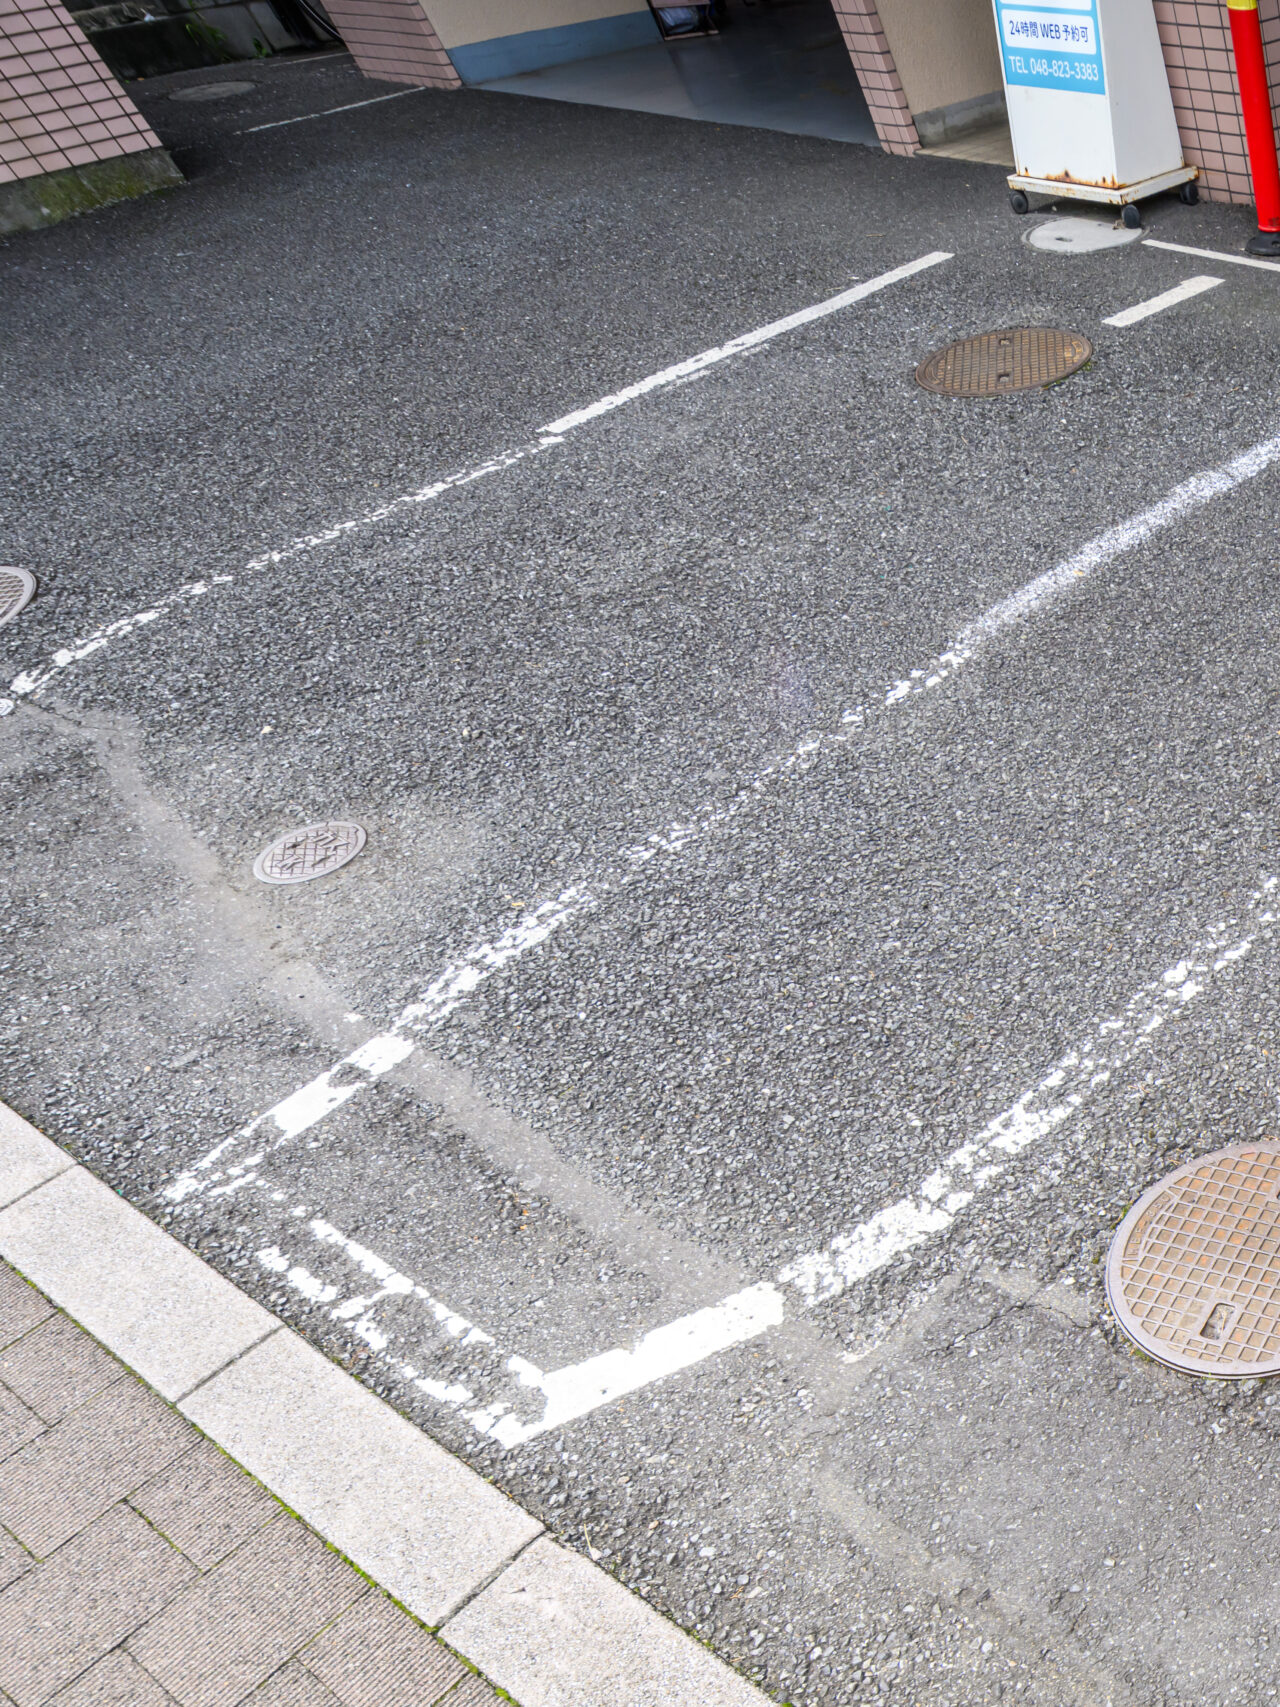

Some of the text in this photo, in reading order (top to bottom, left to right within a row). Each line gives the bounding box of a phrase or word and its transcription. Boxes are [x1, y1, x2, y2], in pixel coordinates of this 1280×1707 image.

[1009, 20, 1089, 43] 24時間 WEB 予約可
[1008, 56, 1099, 82] TEL 048-823-3383
